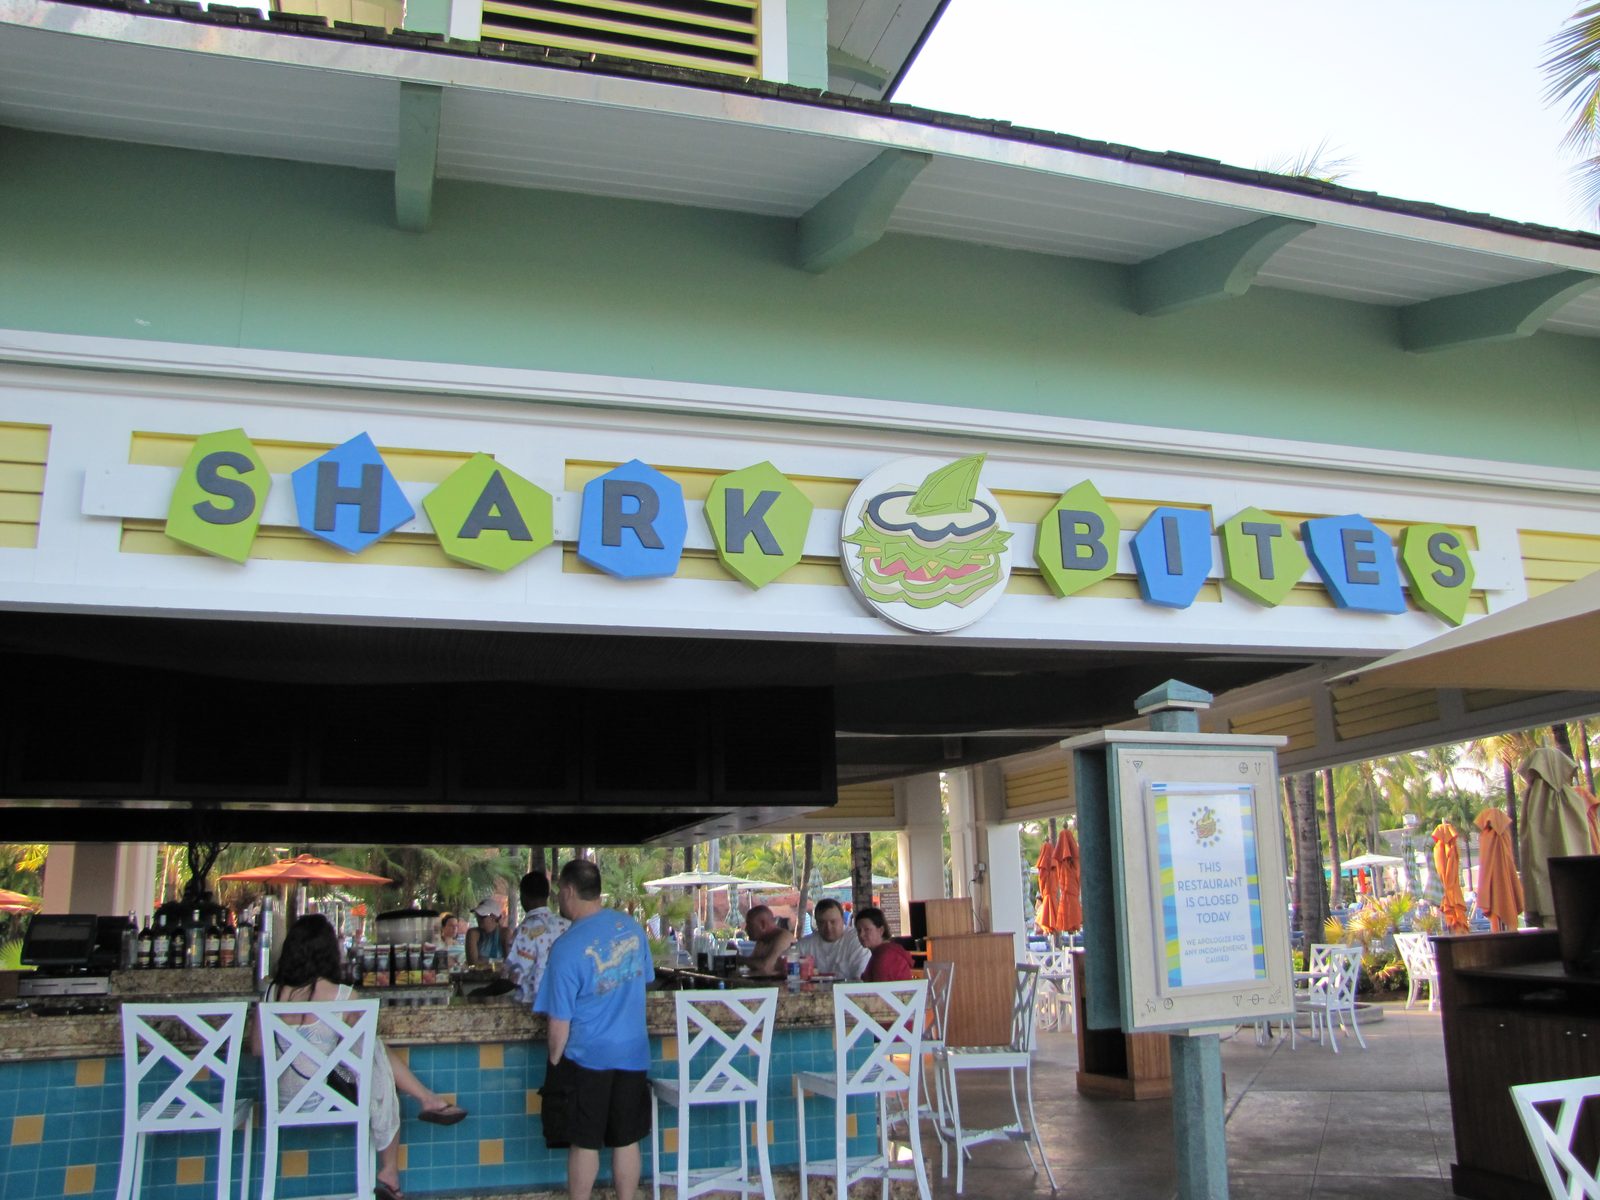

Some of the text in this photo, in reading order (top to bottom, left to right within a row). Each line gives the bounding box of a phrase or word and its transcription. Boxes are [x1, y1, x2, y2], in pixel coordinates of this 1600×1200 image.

[192, 450, 1468, 588] SHARK BITES
[1198, 862, 1222, 873] THIS
[1178, 877, 1243, 891] RESTAURANT
[1186, 894, 1239, 908] IS CLOSED
[1196, 911, 1231, 924] TODAY
[1198, 936, 1231, 945] APOLOGIZE
[1232, 934, 1246, 942] FOR
[1185, 944, 1248, 956] ANY INCONVENIENCE
[1206, 955, 1230, 964] CAUSED
